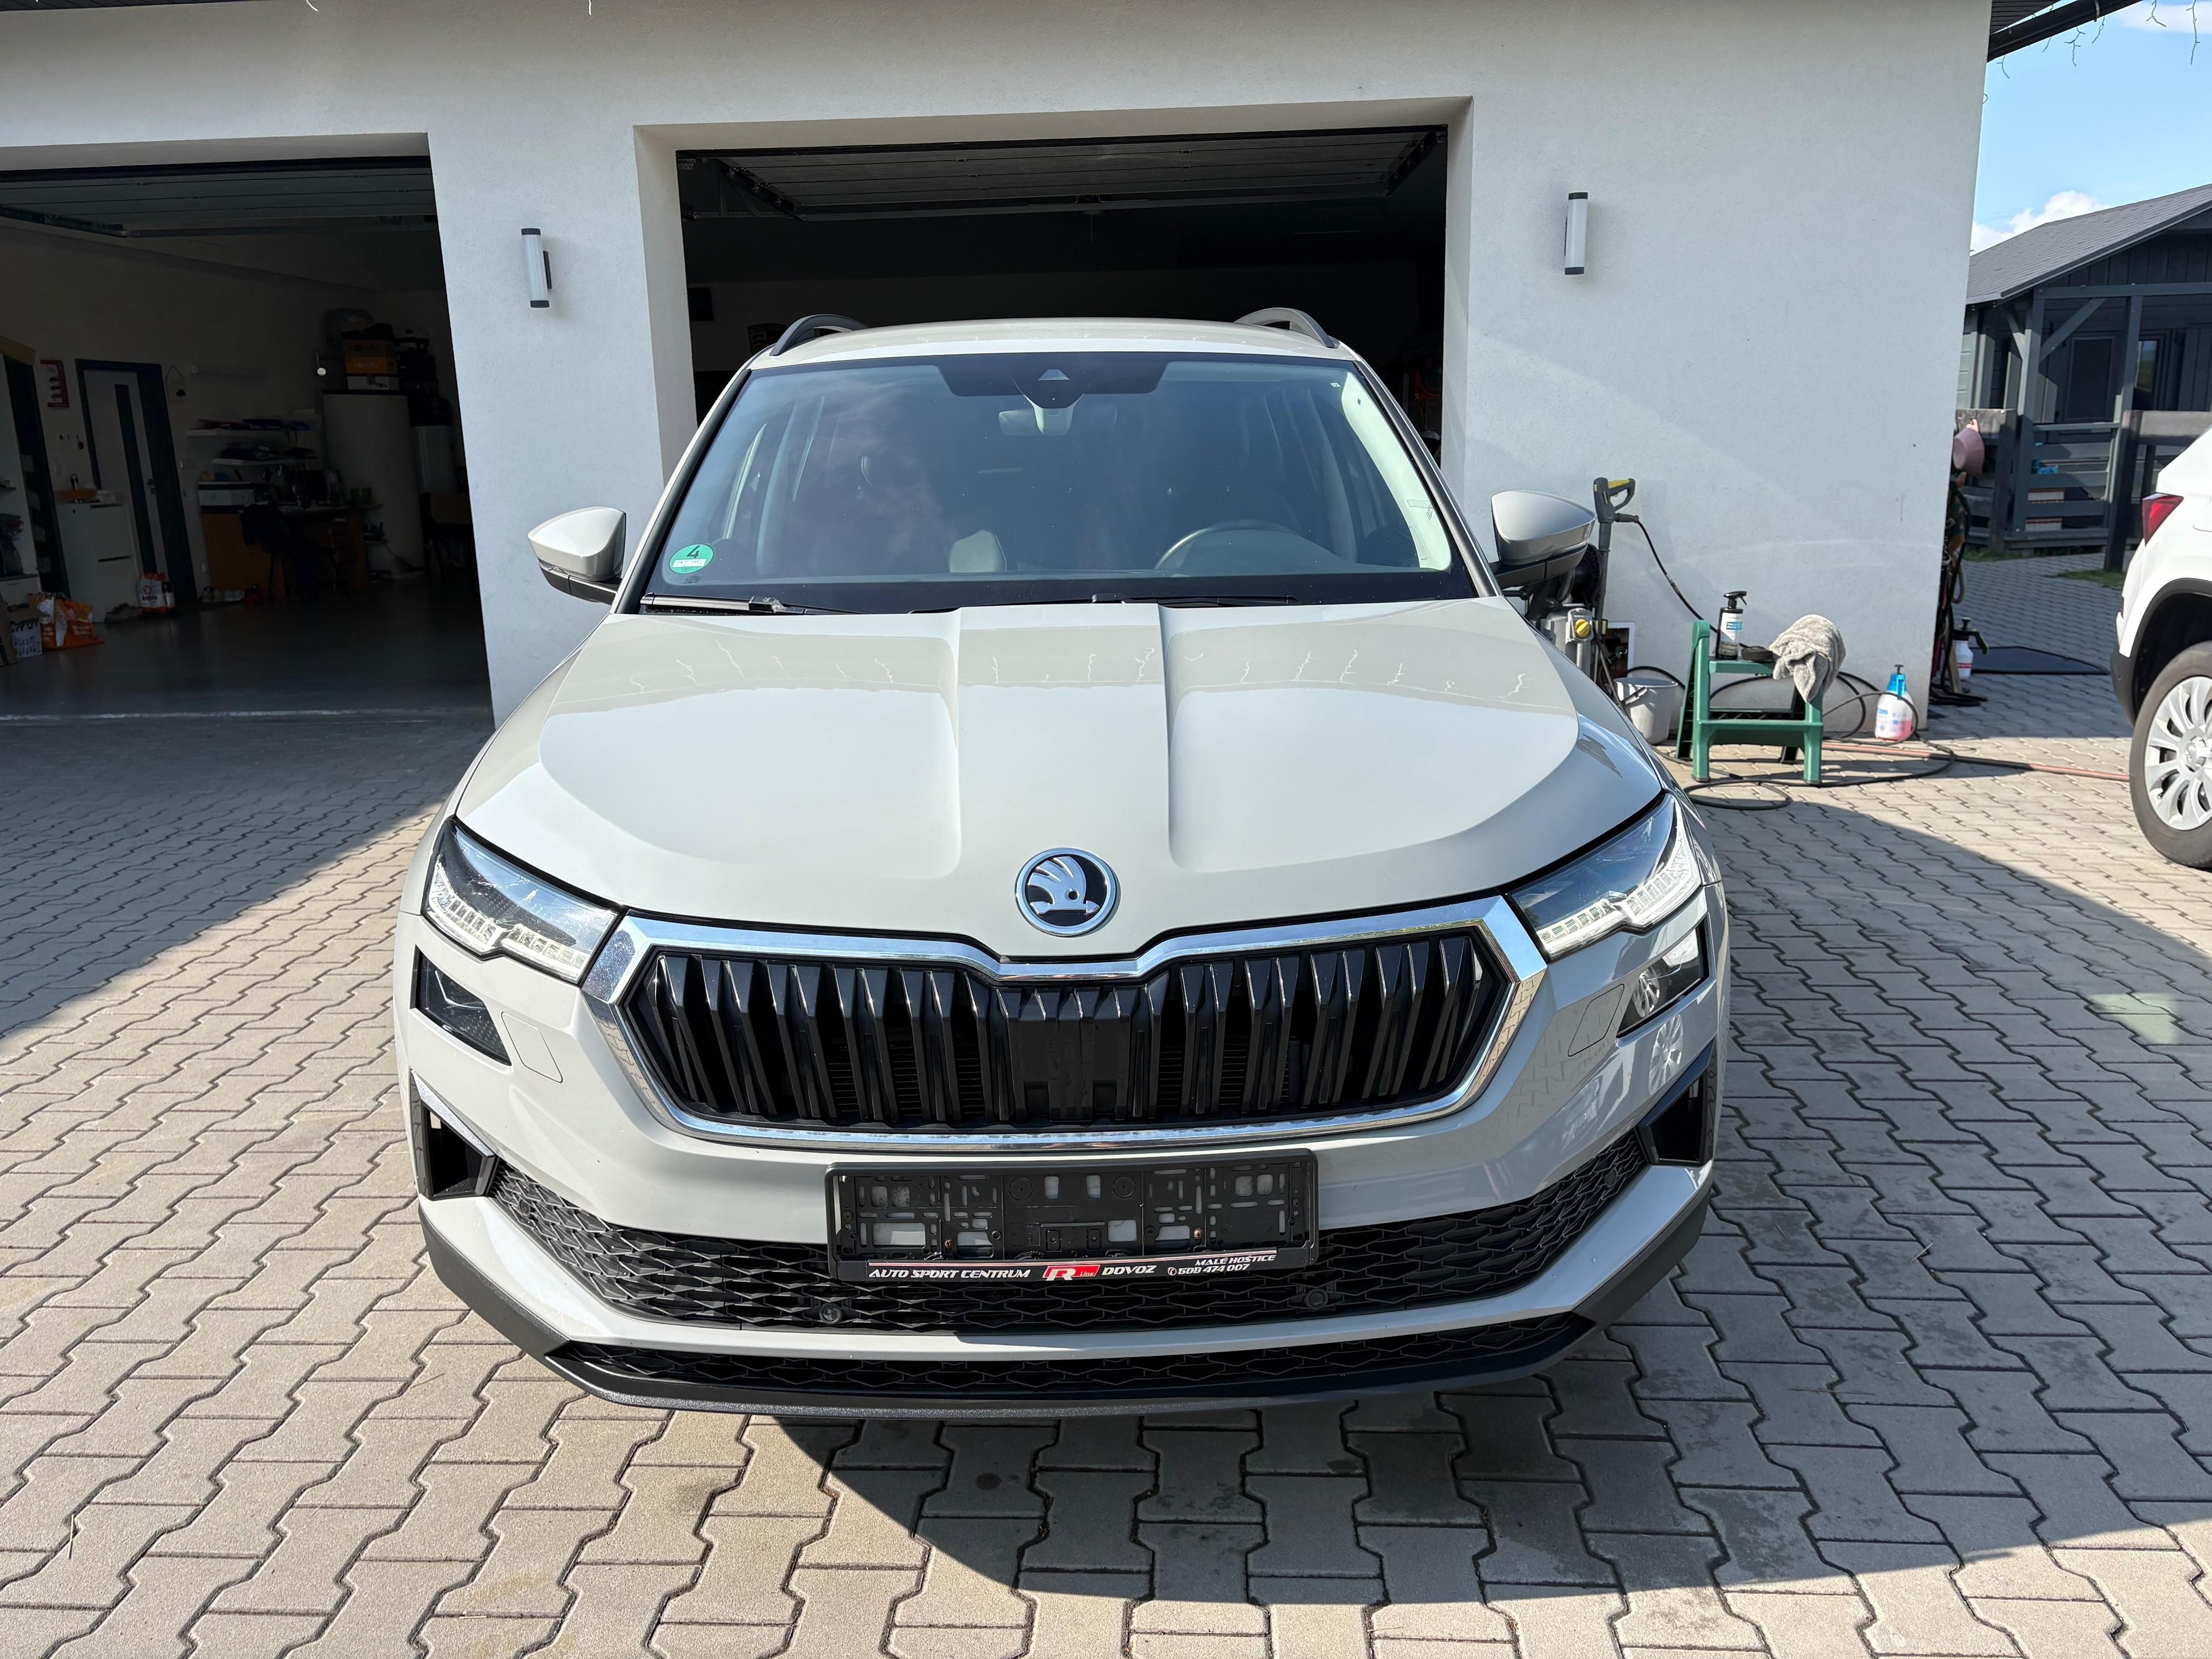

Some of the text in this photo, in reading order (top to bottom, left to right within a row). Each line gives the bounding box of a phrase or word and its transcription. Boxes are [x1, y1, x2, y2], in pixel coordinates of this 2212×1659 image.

[687, 545, 700, 558] 4
[1195, 1255, 1277, 1266] MALÉ HOŠTICE
[1101, 1265, 1157, 1276] DOVOZ
[1203, 1265, 1225, 1273] 474
[1226, 1263, 1251, 1272] 007
[868, 1269, 1031, 1279] AUTO SPORT CENTRUM
[1046, 1268, 1076, 1282] R
